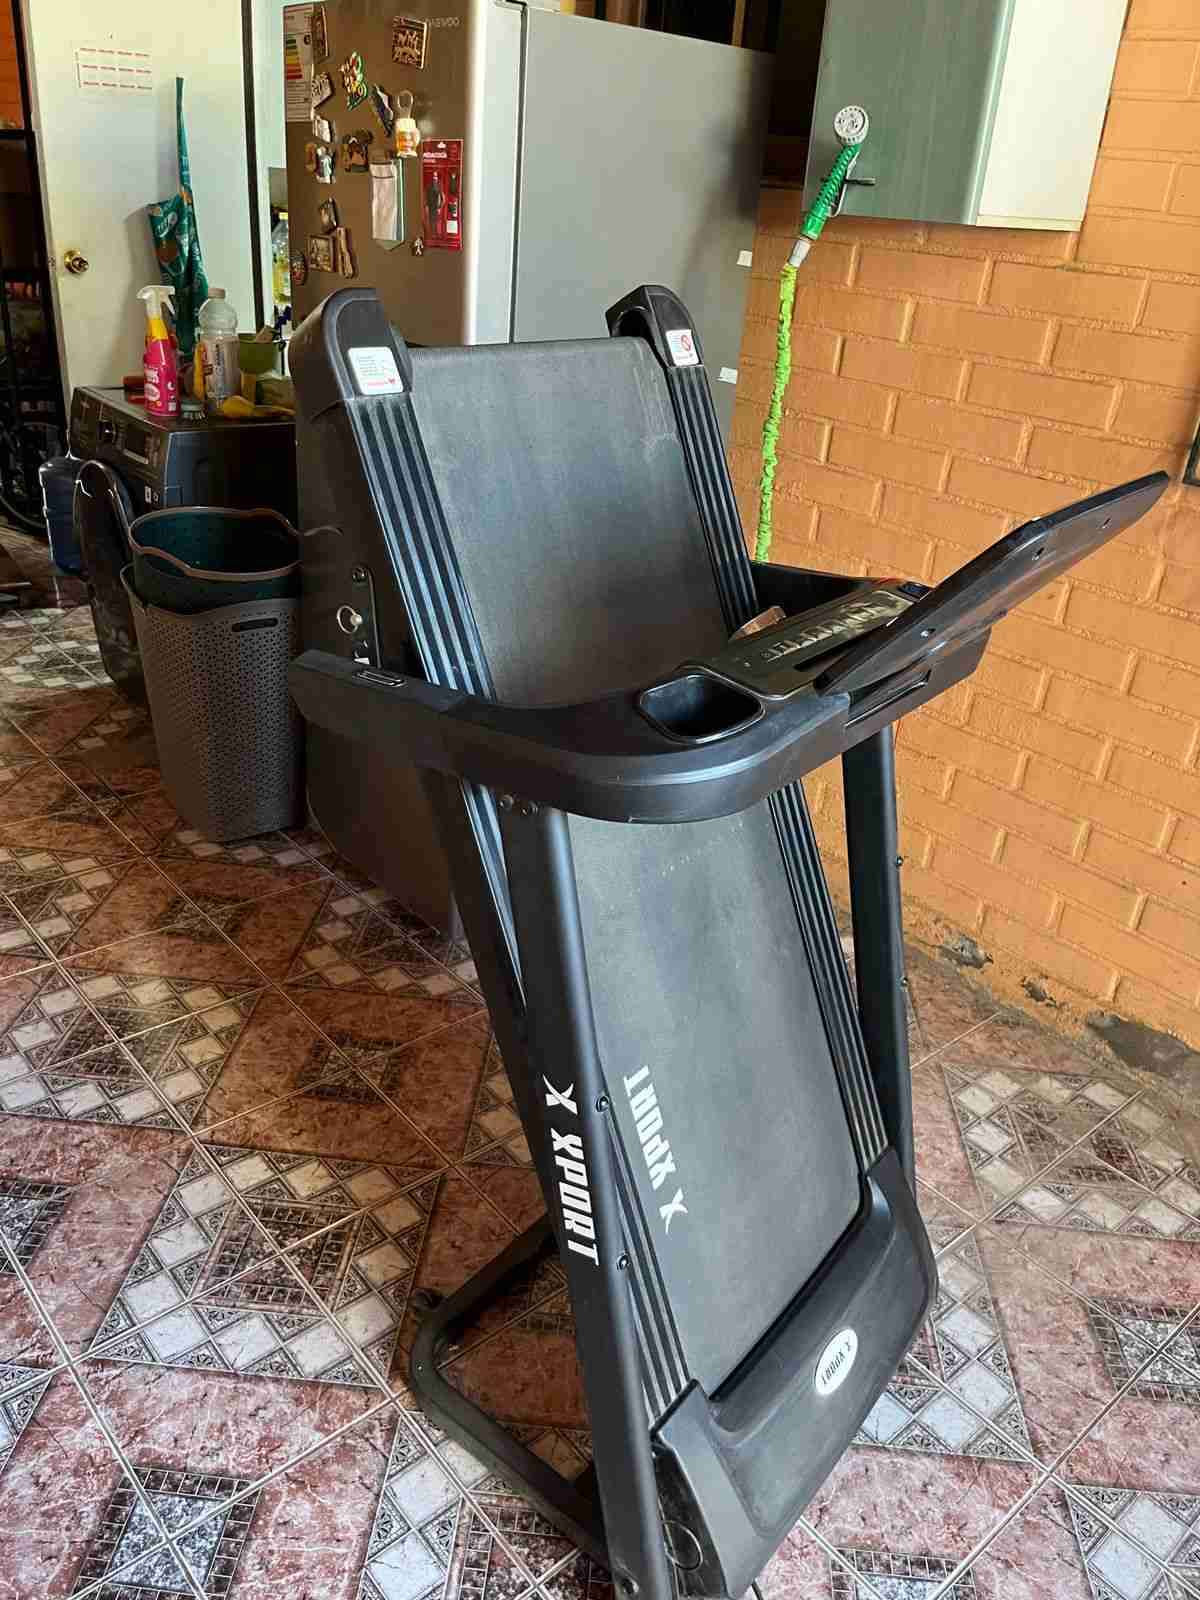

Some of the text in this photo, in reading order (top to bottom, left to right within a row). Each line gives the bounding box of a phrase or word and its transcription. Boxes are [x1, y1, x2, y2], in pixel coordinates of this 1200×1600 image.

[542, 1074, 600, 1266] X XPORT
[624, 1065, 689, 1235] X XPORT
[822, 1351, 846, 1385] XPORT
